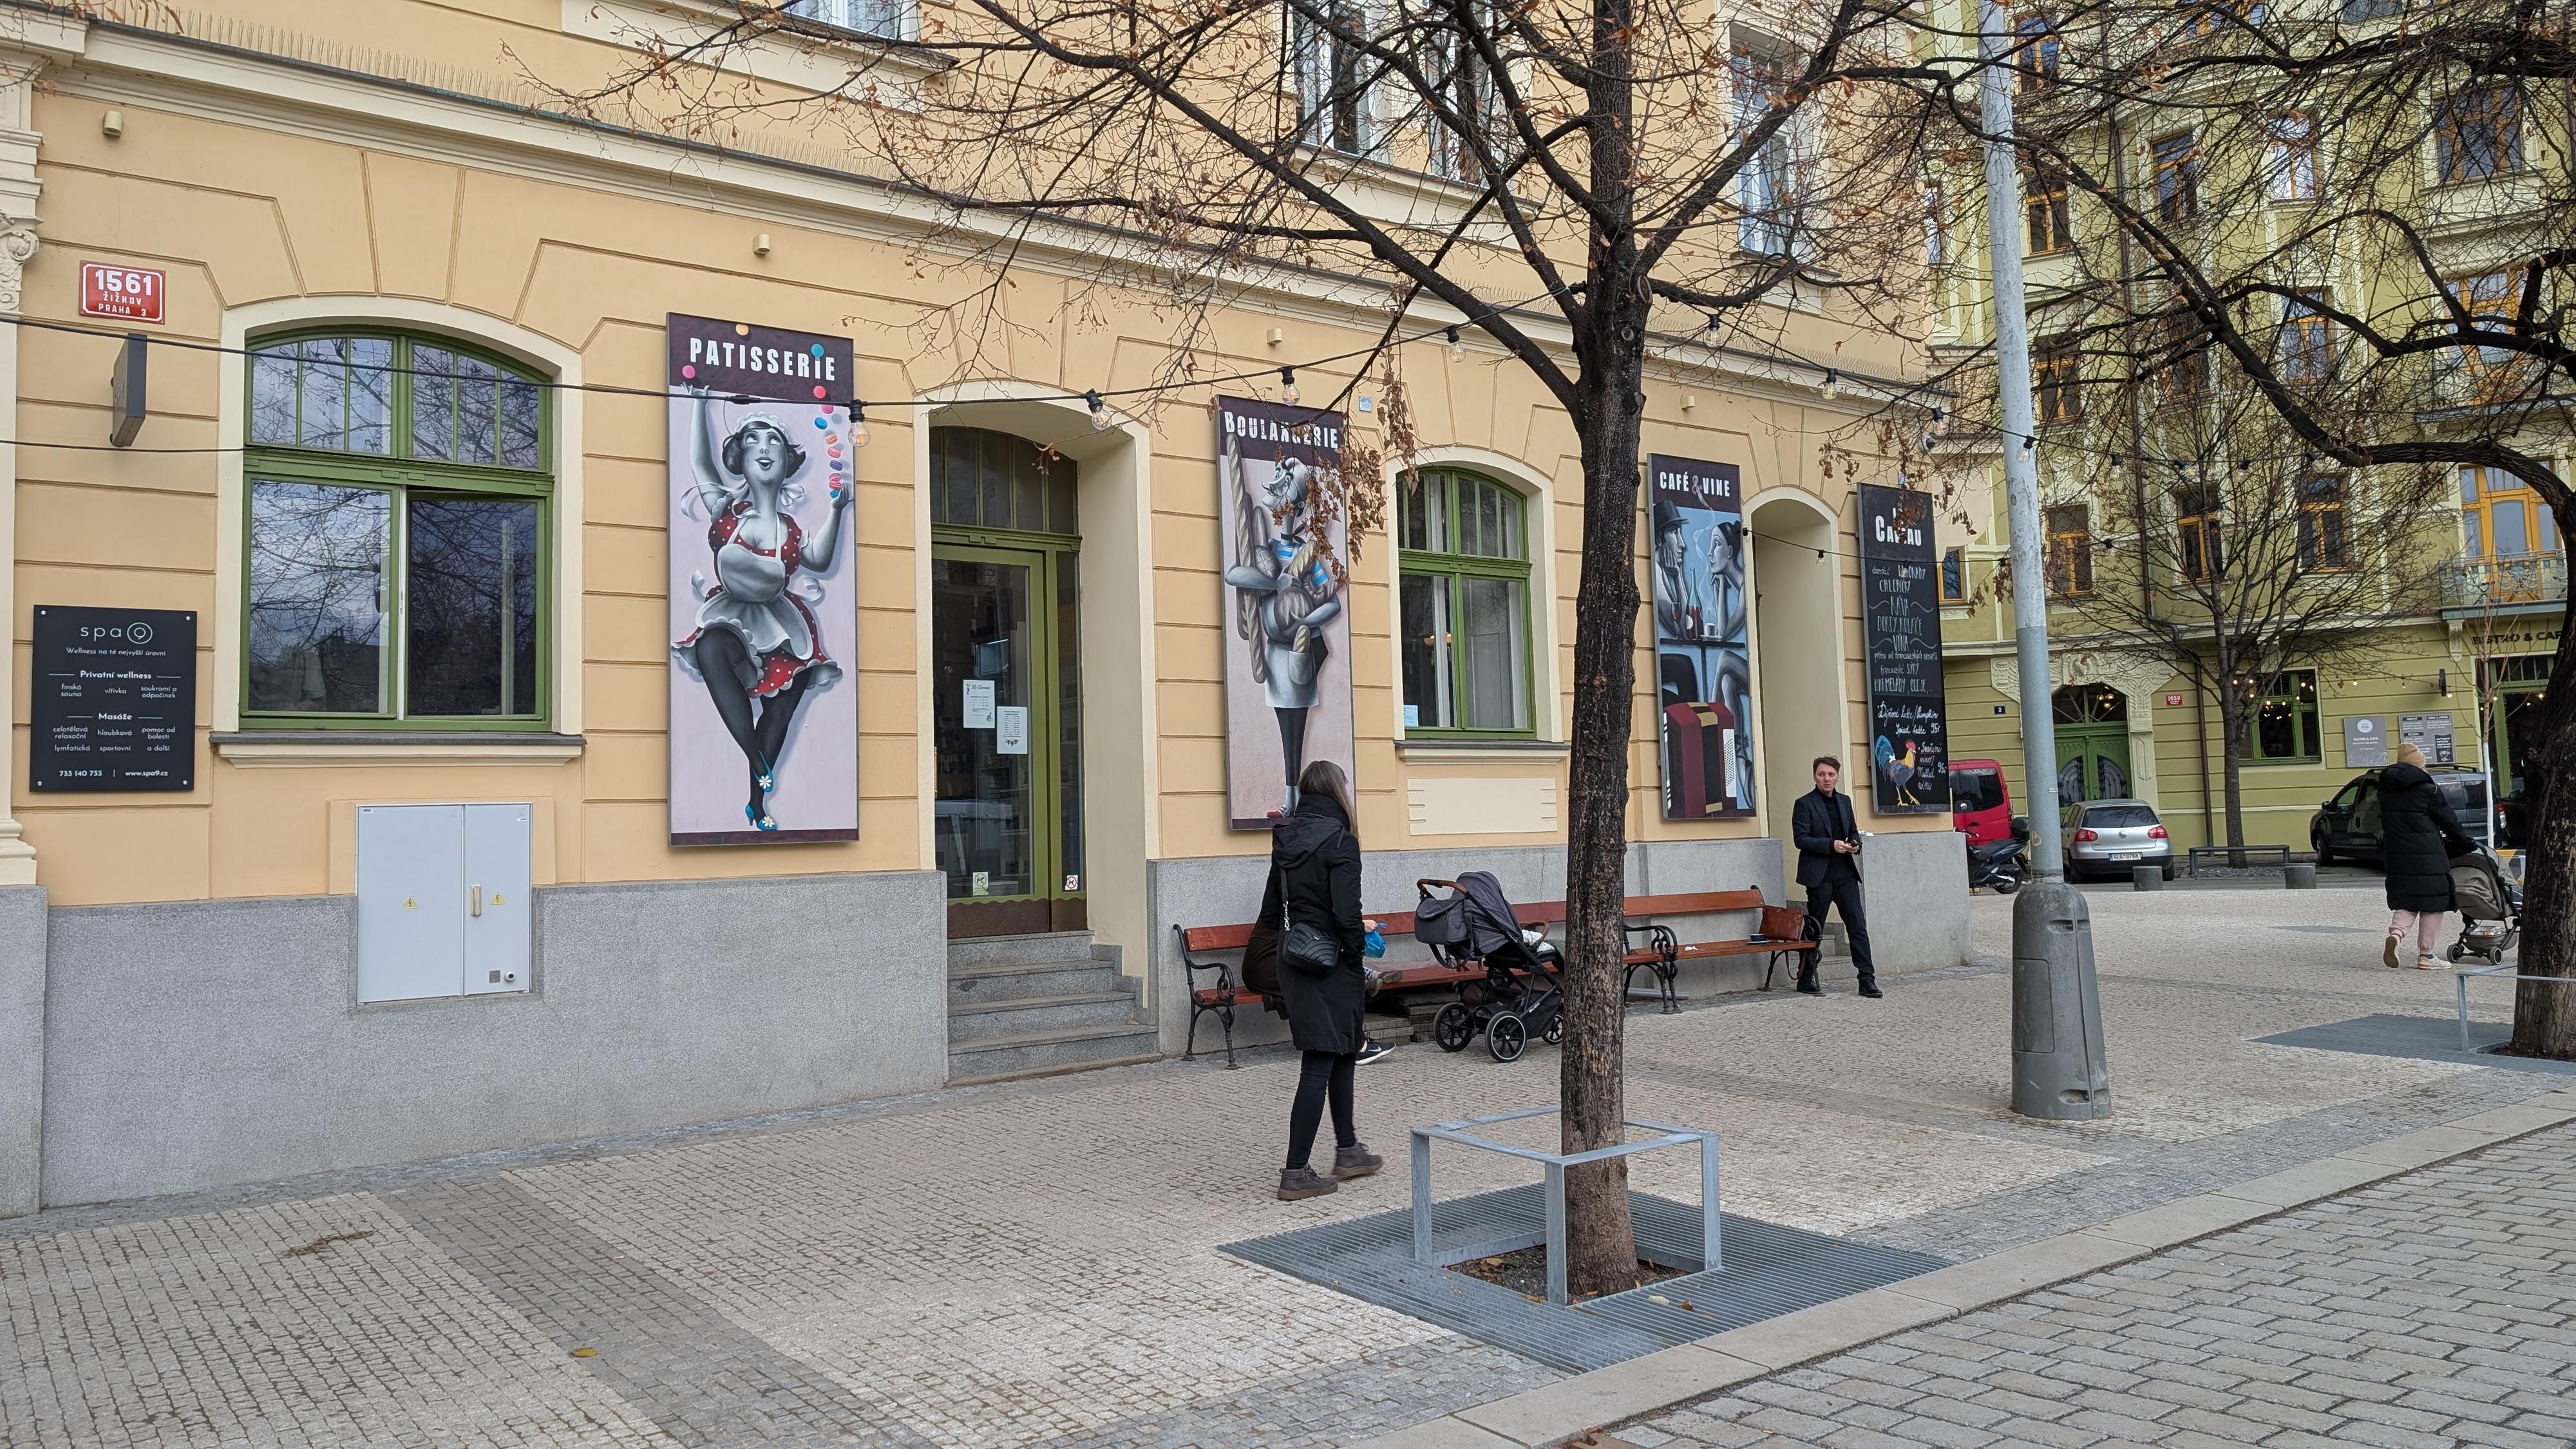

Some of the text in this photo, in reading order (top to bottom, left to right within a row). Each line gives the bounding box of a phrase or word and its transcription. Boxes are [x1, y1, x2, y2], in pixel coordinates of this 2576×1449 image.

[95, 269, 151, 296] 1561
[102, 291, 142, 305] ŽIŽKOV
[98, 303, 146, 317] PRAHA 3
[690, 337, 835, 381] PATISSERIE
[1660, 471, 1689, 492] CAFÉ
[1703, 477, 1730, 497] VINE
[1890, 595, 1910, 616] KÁVA
[2472, 630, 2562, 645] BISTRO & CAF
[80, 670, 115, 679] Privatní
